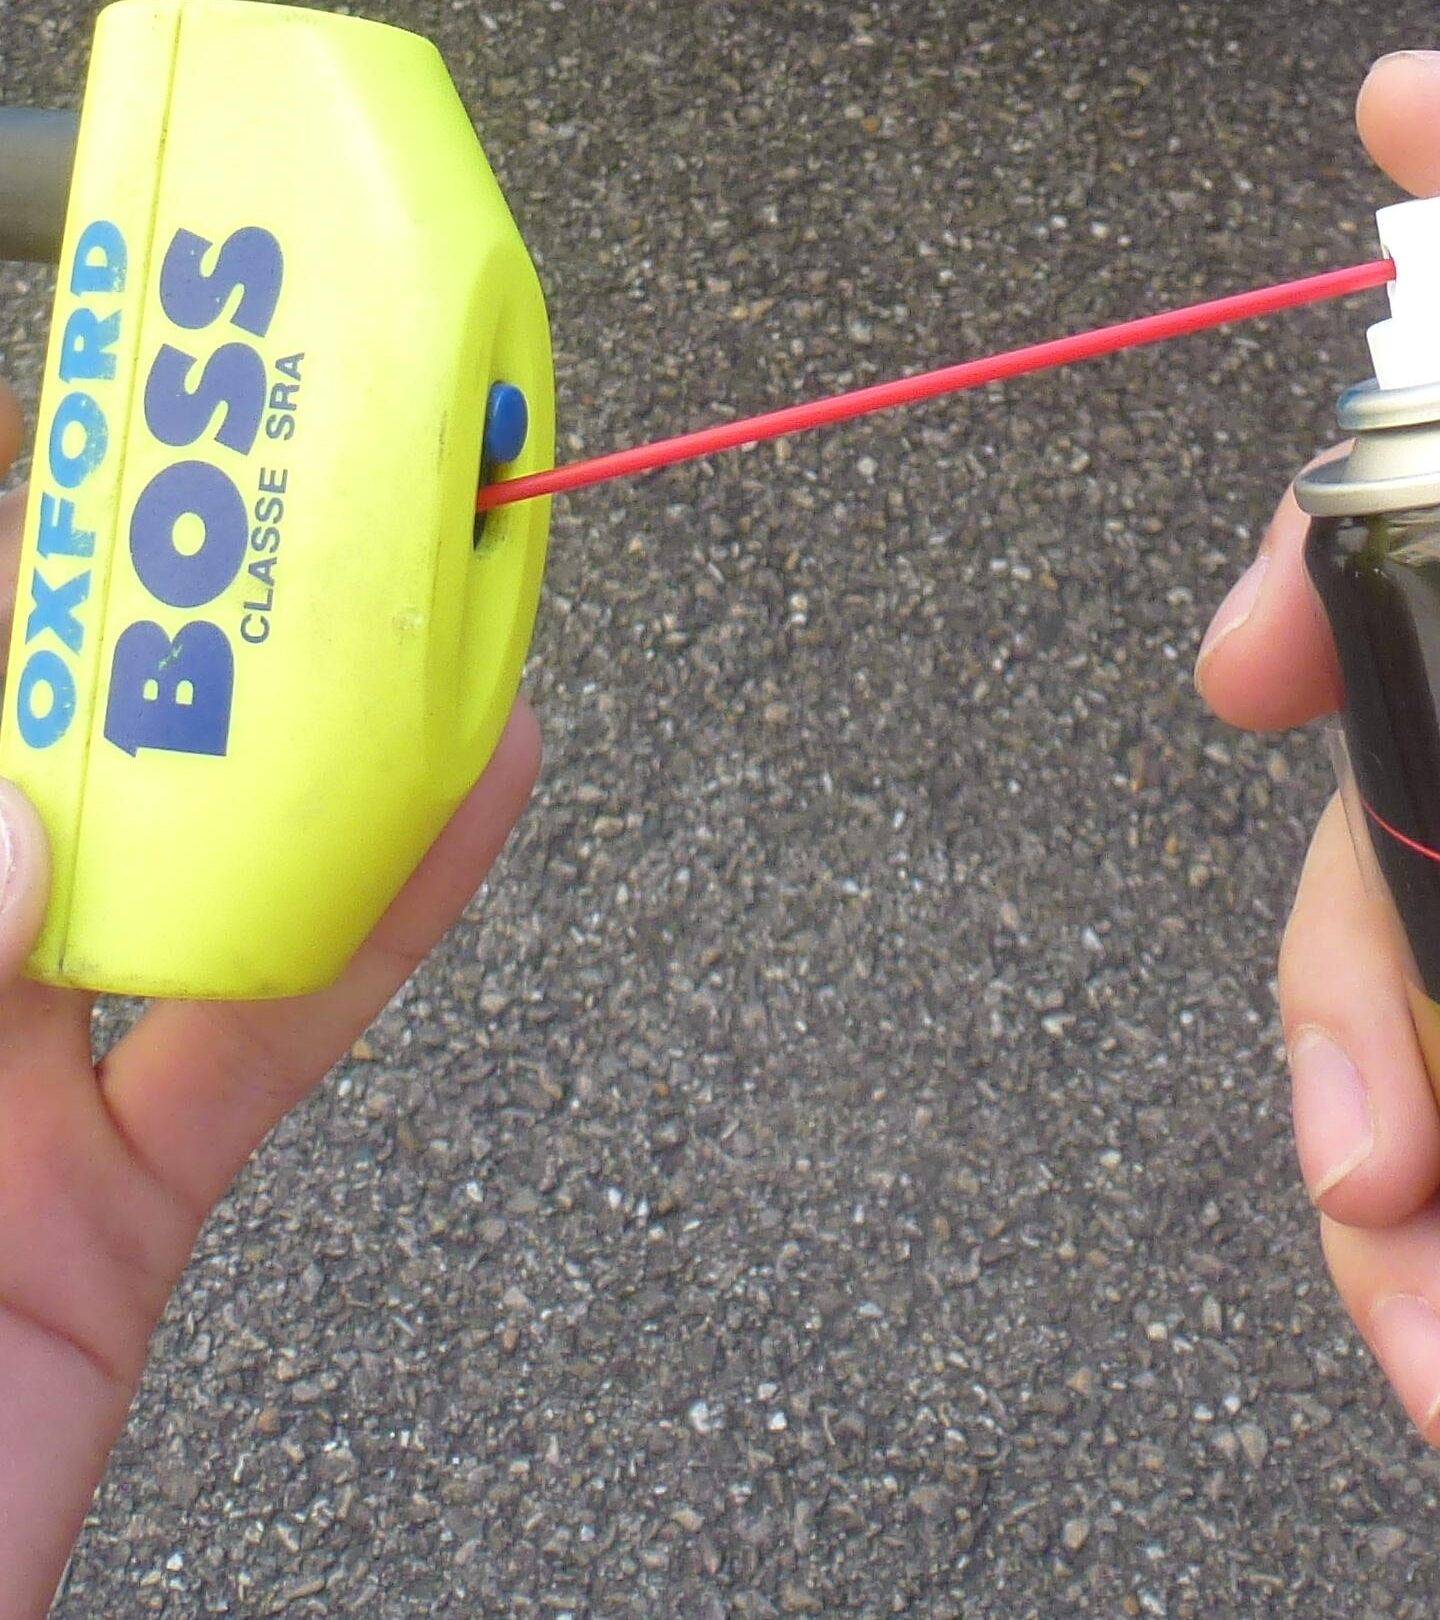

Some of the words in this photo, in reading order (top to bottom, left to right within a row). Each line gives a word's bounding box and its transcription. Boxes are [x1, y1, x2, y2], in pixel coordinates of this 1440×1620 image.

[17, 220, 128, 749] OXFORD
[104, 226, 284, 757] BOSS
[241, 467, 289, 644] CLASSE
[266, 351, 306, 441] SRA
